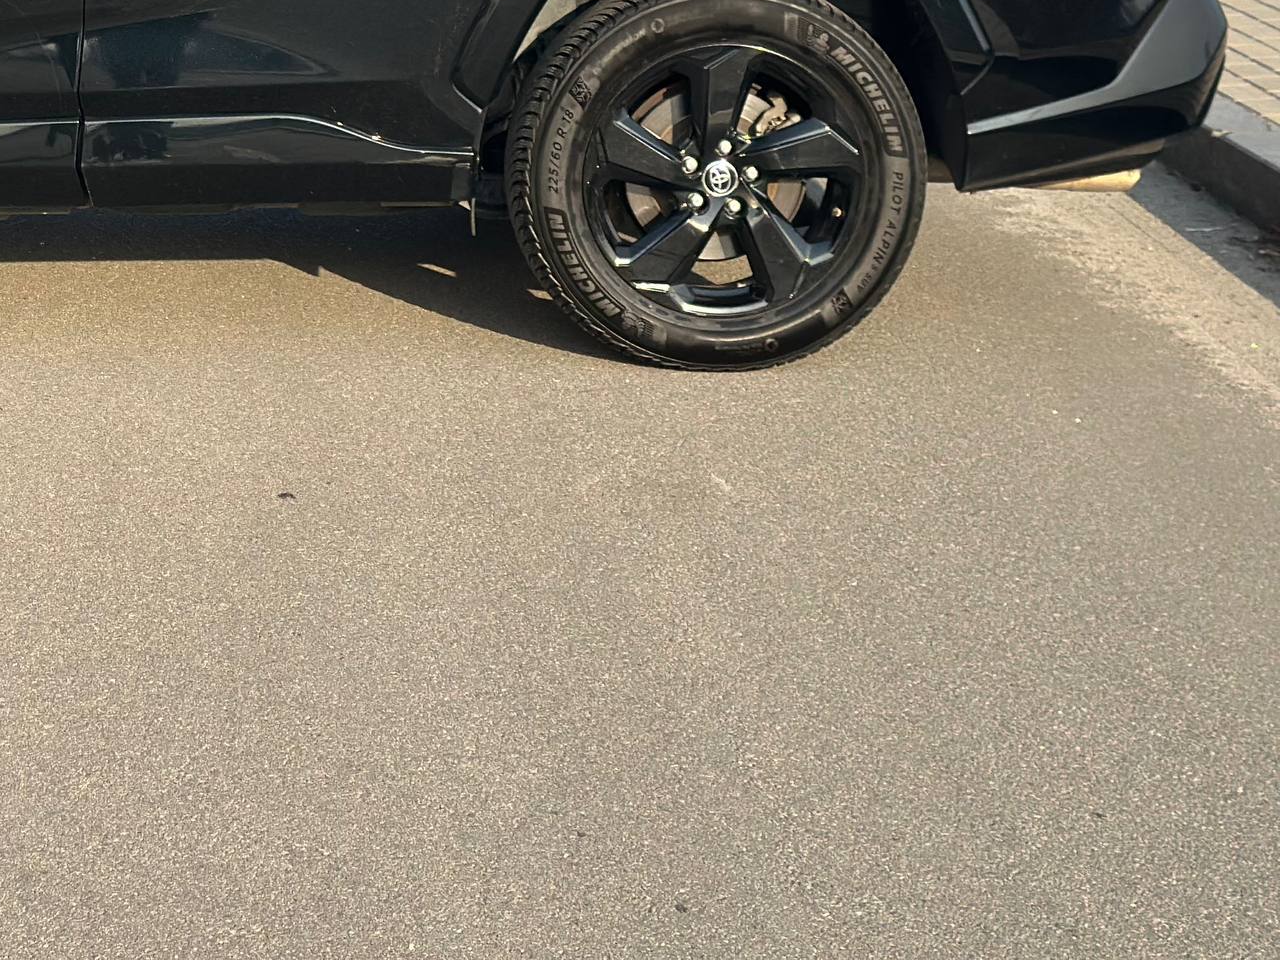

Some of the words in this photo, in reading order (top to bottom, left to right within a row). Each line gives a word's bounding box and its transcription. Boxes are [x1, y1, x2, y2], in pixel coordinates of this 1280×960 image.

[561, 108, 575, 126] 18
[830, 45, 903, 153] MICHELIN
[556, 126, 568, 140] R
[548, 140, 563, 194] 225/60
[889, 171, 904, 219] PILOT
[547, 213, 621, 319] MICHELIN
[871, 220, 898, 265] ALPIN
